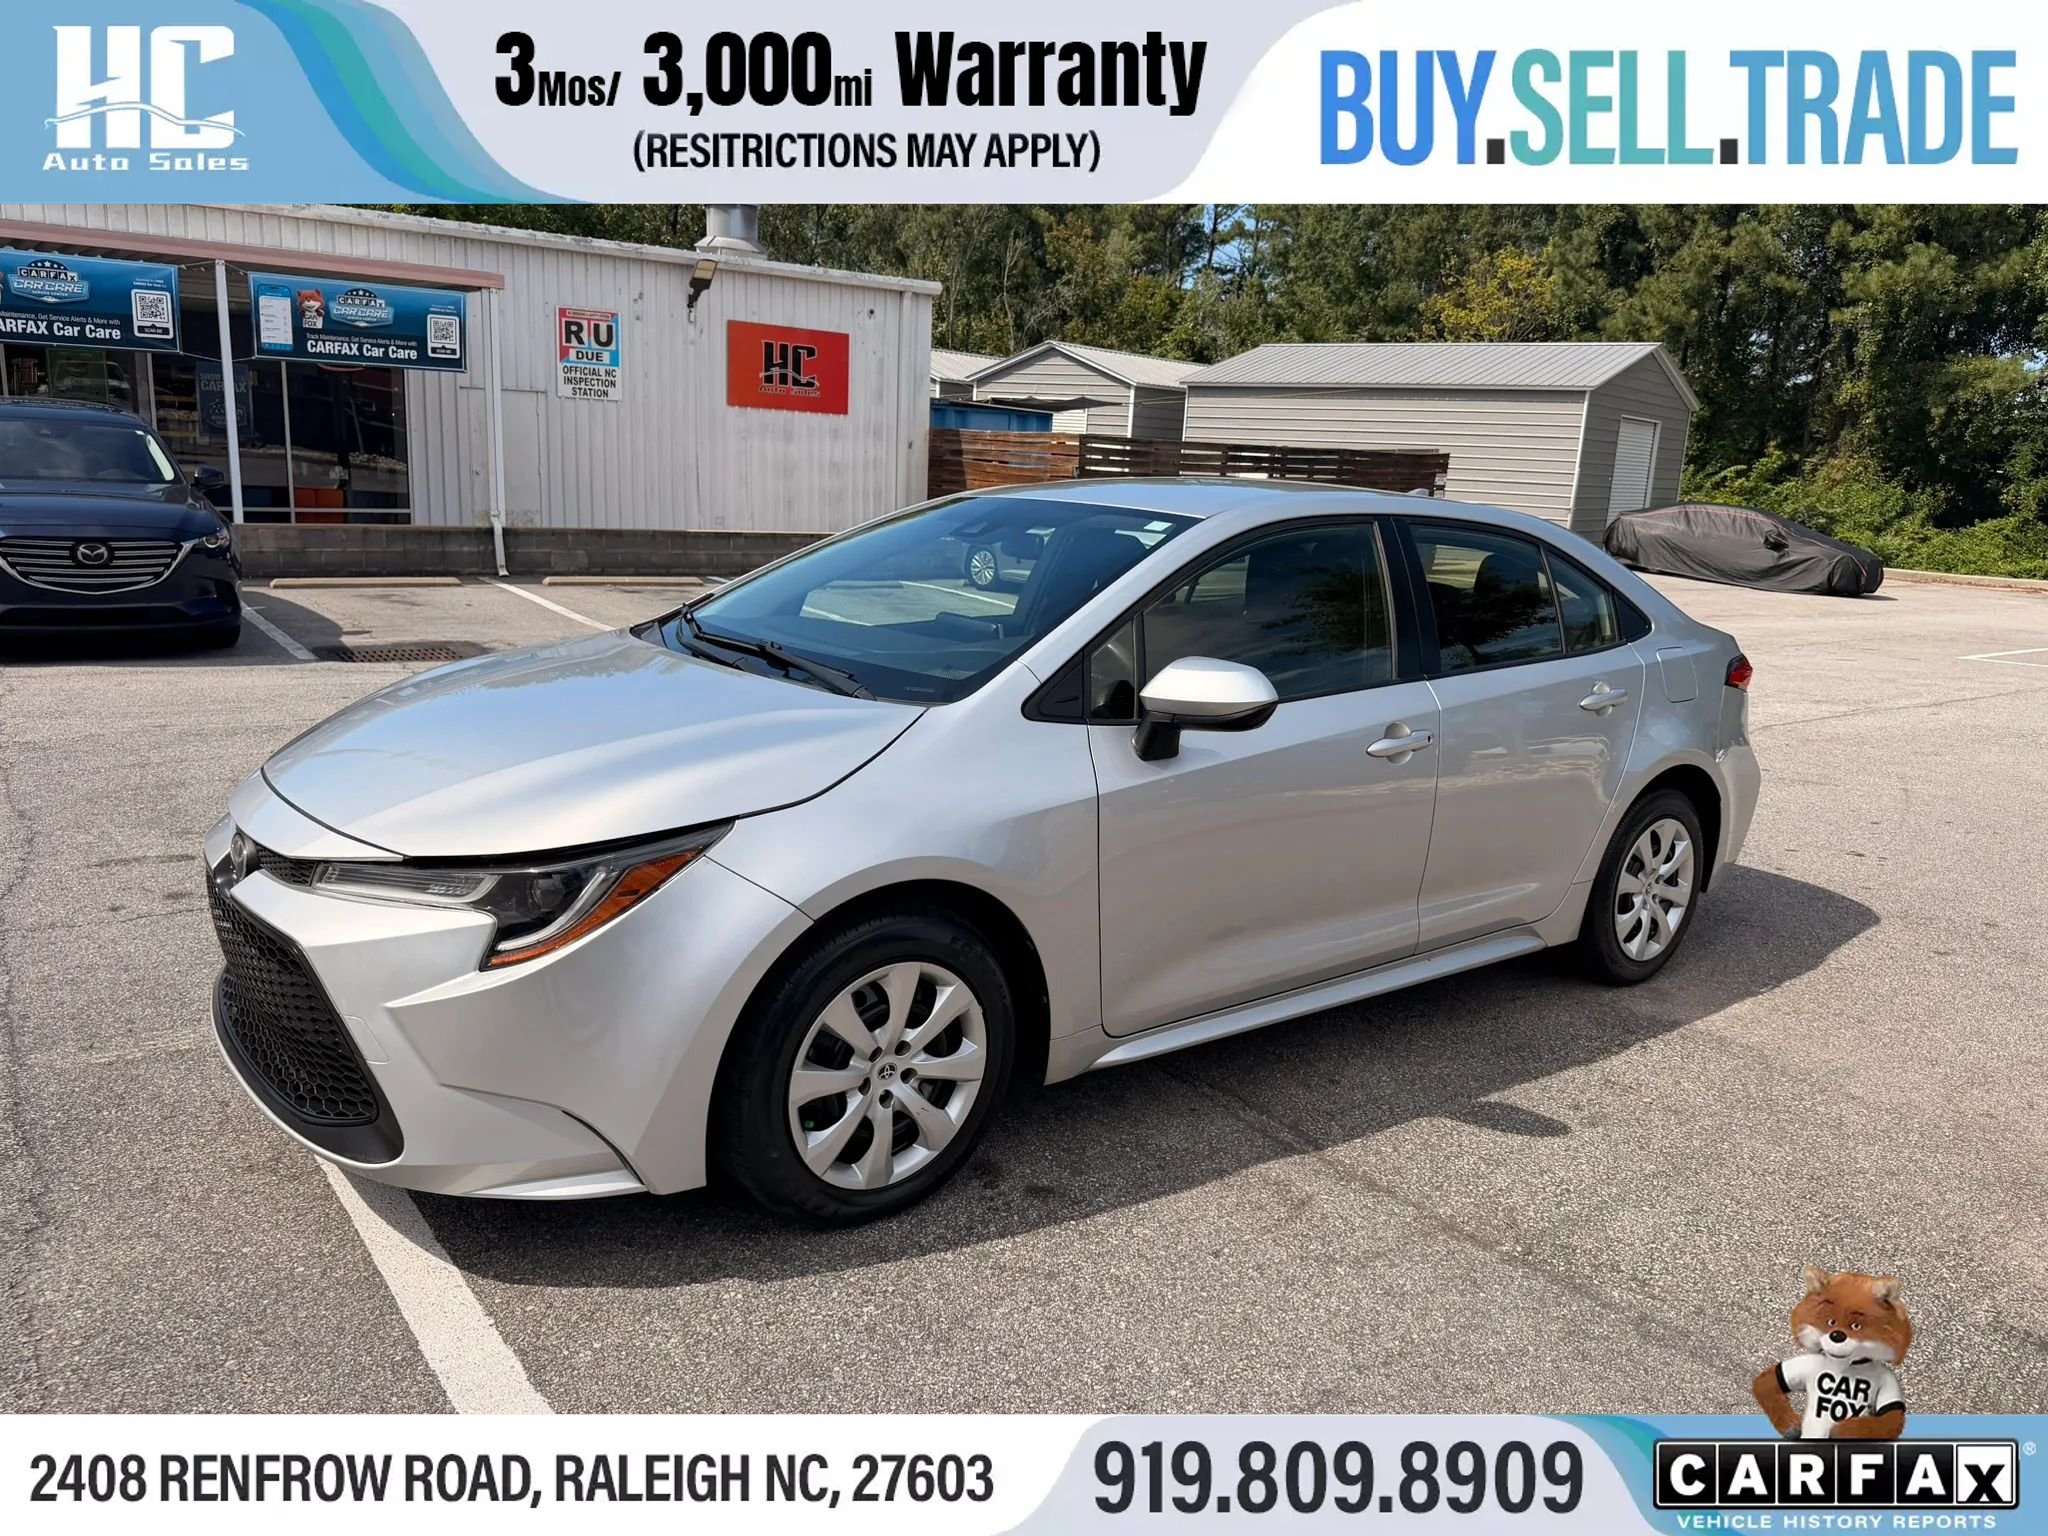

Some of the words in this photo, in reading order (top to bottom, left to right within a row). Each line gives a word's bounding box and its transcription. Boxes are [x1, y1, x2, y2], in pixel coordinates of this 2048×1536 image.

[20, 269, 78, 282] CARFAX
[14, 279, 43, 290] CAR
[45, 282, 83, 293] CARE
[339, 297, 385, 307] CARFAX
[49, 314, 70, 322] Service
[93, 317, 108, 325] More
[304, 320, 317, 328] FOX
[53, 321, 80, 337] Car
[85, 324, 121, 340] Care
[306, 339, 360, 356] CARFAX
[362, 343, 386, 358] Car
[388, 345, 418, 360] Care
[575, 350, 605, 362] DUE
[760, 340, 820, 390] HC
[562, 365, 602, 377] OFFICIAL
[604, 368, 617, 379] NC
[200, 380, 248, 393] CARAX
[563, 375, 617, 389] INSPECTION
[571, 386, 609, 399] STATION
